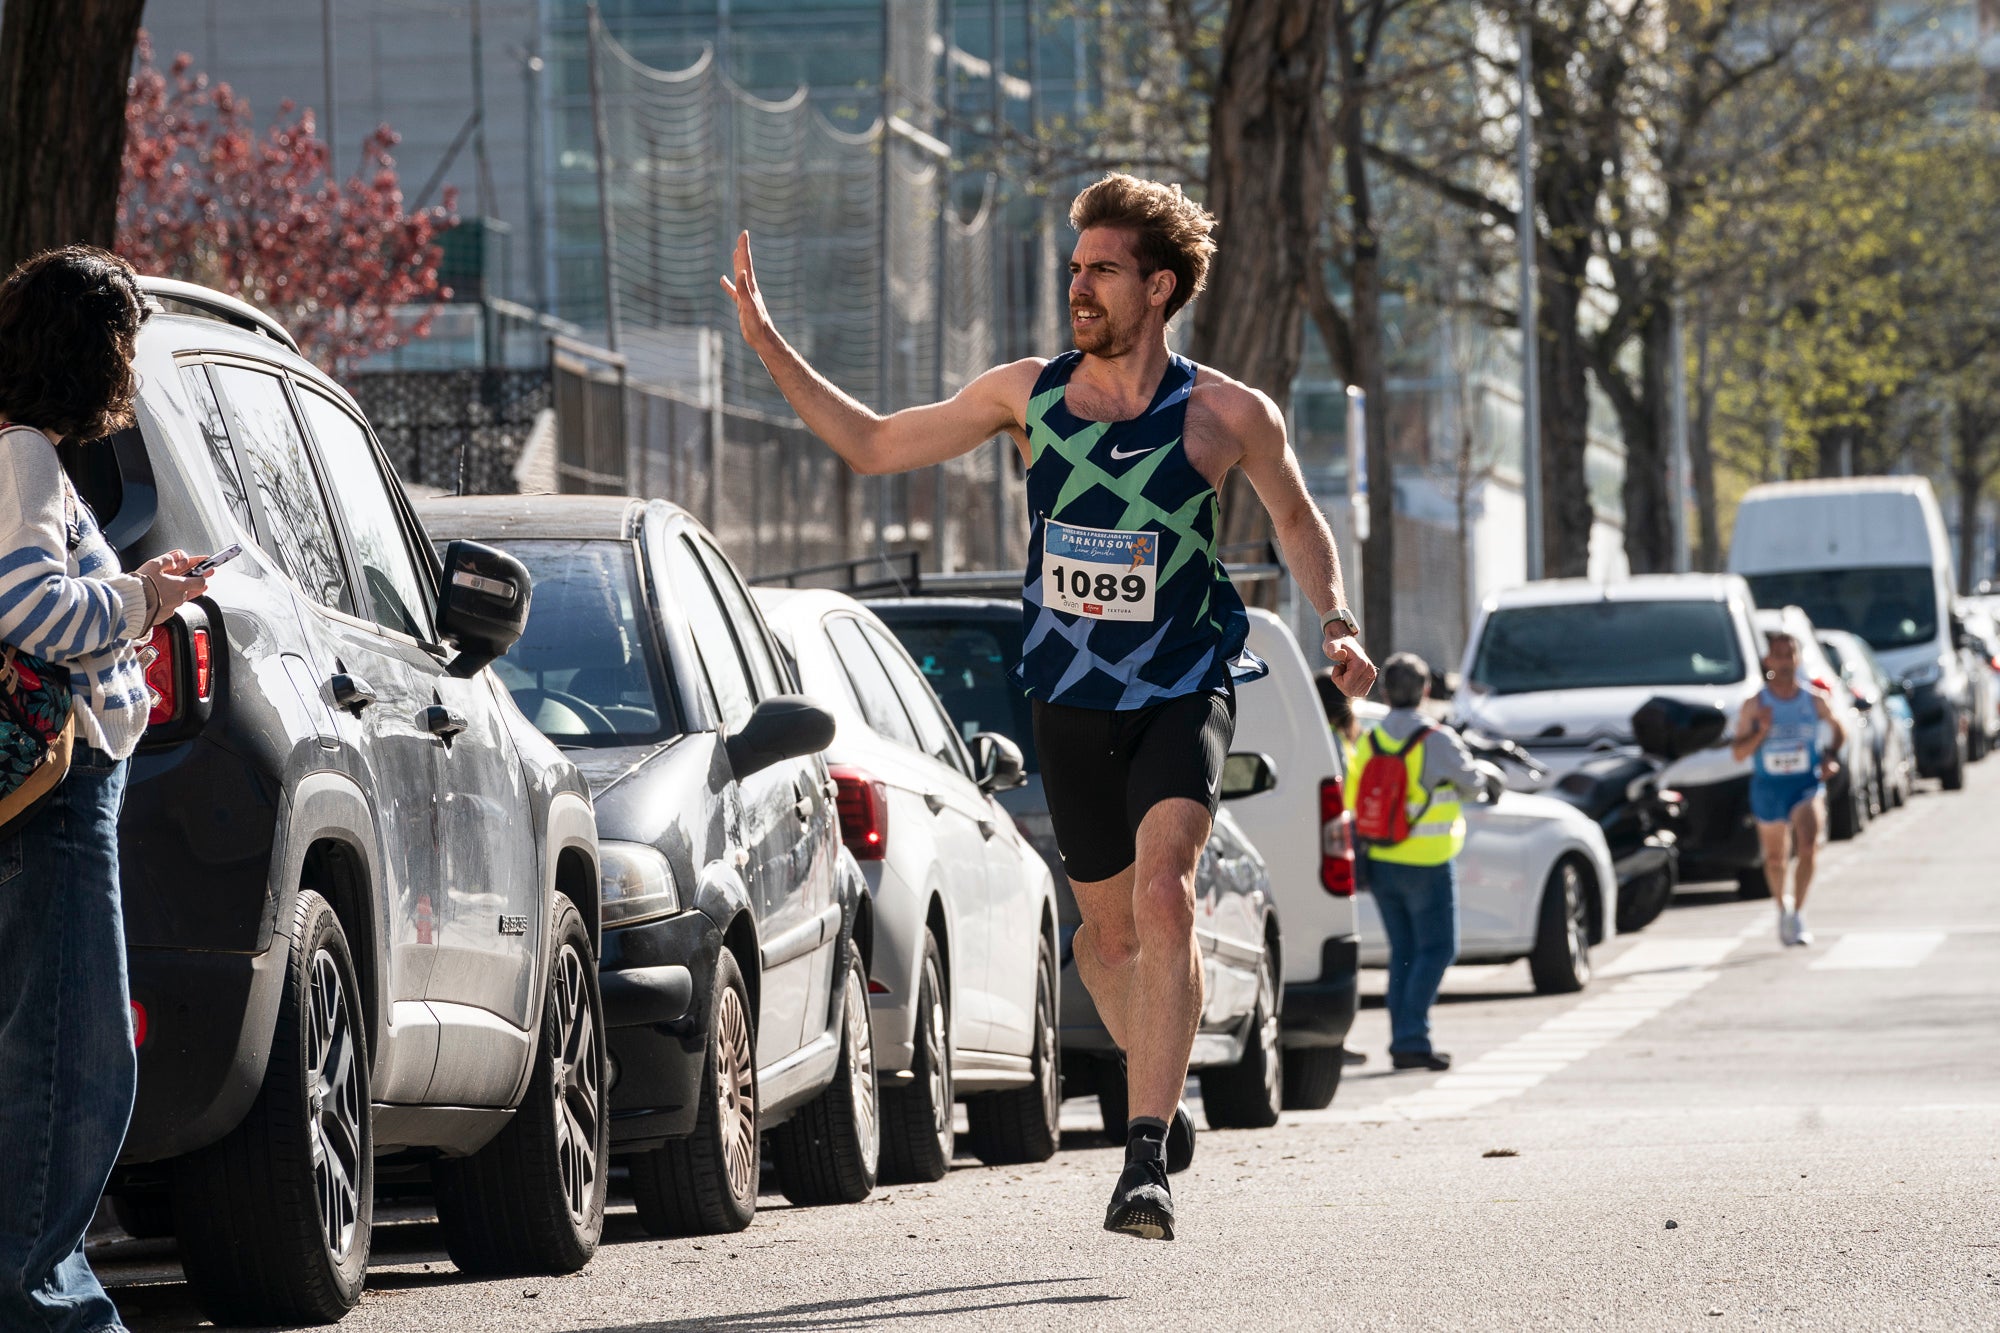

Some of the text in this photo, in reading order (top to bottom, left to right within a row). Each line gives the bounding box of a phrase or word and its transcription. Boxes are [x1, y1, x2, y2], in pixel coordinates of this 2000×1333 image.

[1062, 534, 1133, 549] PARKINSON
[1052, 565, 1146, 603] 1089
[1063, 600, 1079, 609] avan
